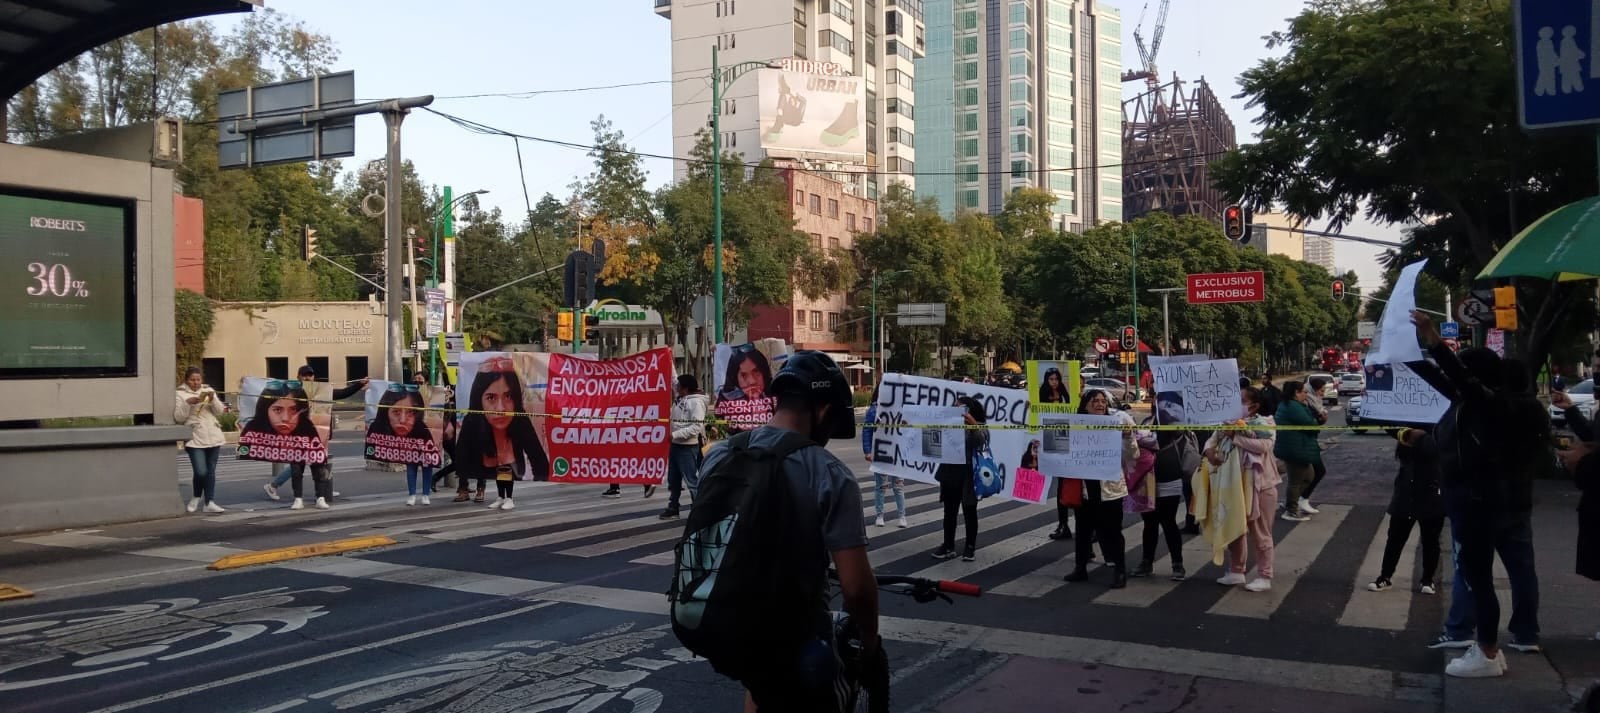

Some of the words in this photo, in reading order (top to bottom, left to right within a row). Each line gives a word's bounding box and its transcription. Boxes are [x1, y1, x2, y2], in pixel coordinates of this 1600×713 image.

[806, 77, 857, 95] URBAN
[27, 262, 89, 298] 30%
[1195, 276, 1255, 287] EXCLUSIVO
[1196, 288, 1255, 299] METROBUS
[299, 319, 373, 330] MONTEJO
[560, 356, 646, 376] AYUDANOS
[648, 353, 659, 371] A
[1208, 363, 1219, 381] A
[550, 373, 667, 396] ENCONTRARLA
[1184, 382, 1241, 399] REGRESA
[718, 397, 777, 408] AYUDANO
[880, 381, 941, 408] JEFA
[561, 405, 660, 424] VALERIA
[1187, 401, 1196, 415] A
[1198, 398, 1231, 413] CASA
[239, 436, 325, 449] ENCONTRARLA
[245, 431, 310, 443] AYUDANOS
[311, 435, 321, 443] A
[370, 432, 425, 445] AYUDANOS
[551, 425, 666, 444] CAMARGO
[366, 437, 440, 451] ENCONTRARLA
[249, 446, 325, 464] 5568588499
[374, 446, 439, 466] 5568588499
[571, 457, 665, 479] 5568588499
